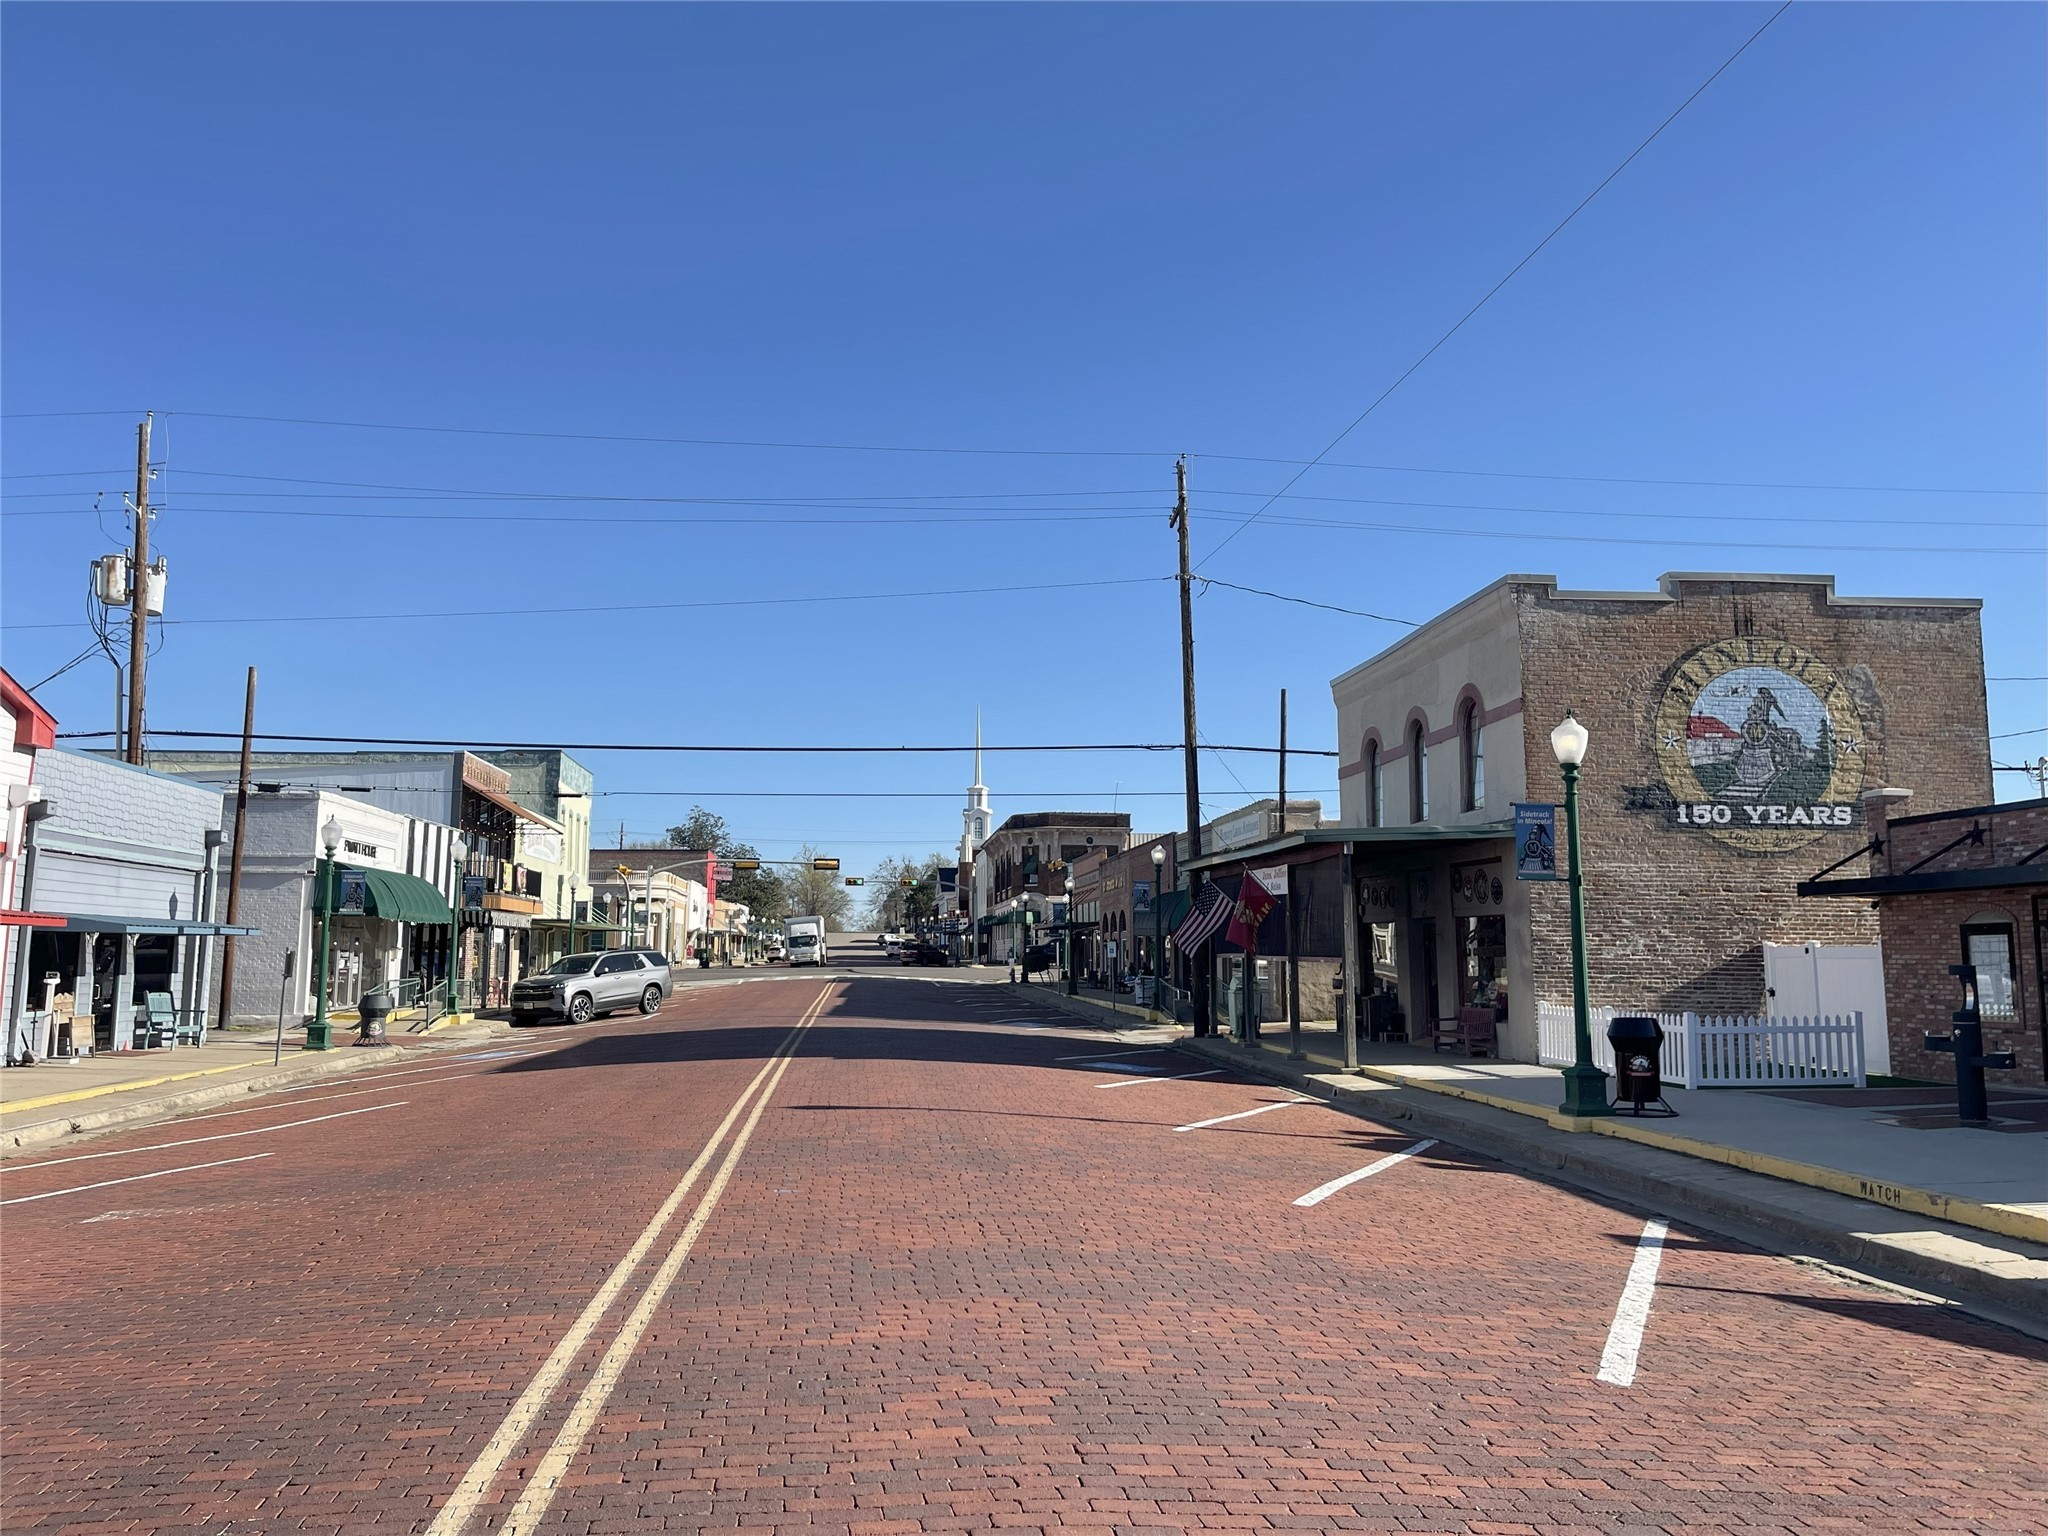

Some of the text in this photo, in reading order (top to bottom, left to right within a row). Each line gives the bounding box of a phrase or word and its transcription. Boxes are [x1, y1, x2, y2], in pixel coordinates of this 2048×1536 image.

[1671, 639, 1837, 704] MINEOLA
[1677, 804, 1852, 825] 150 YEARS
[1860, 1181, 1900, 1203] WATCH
